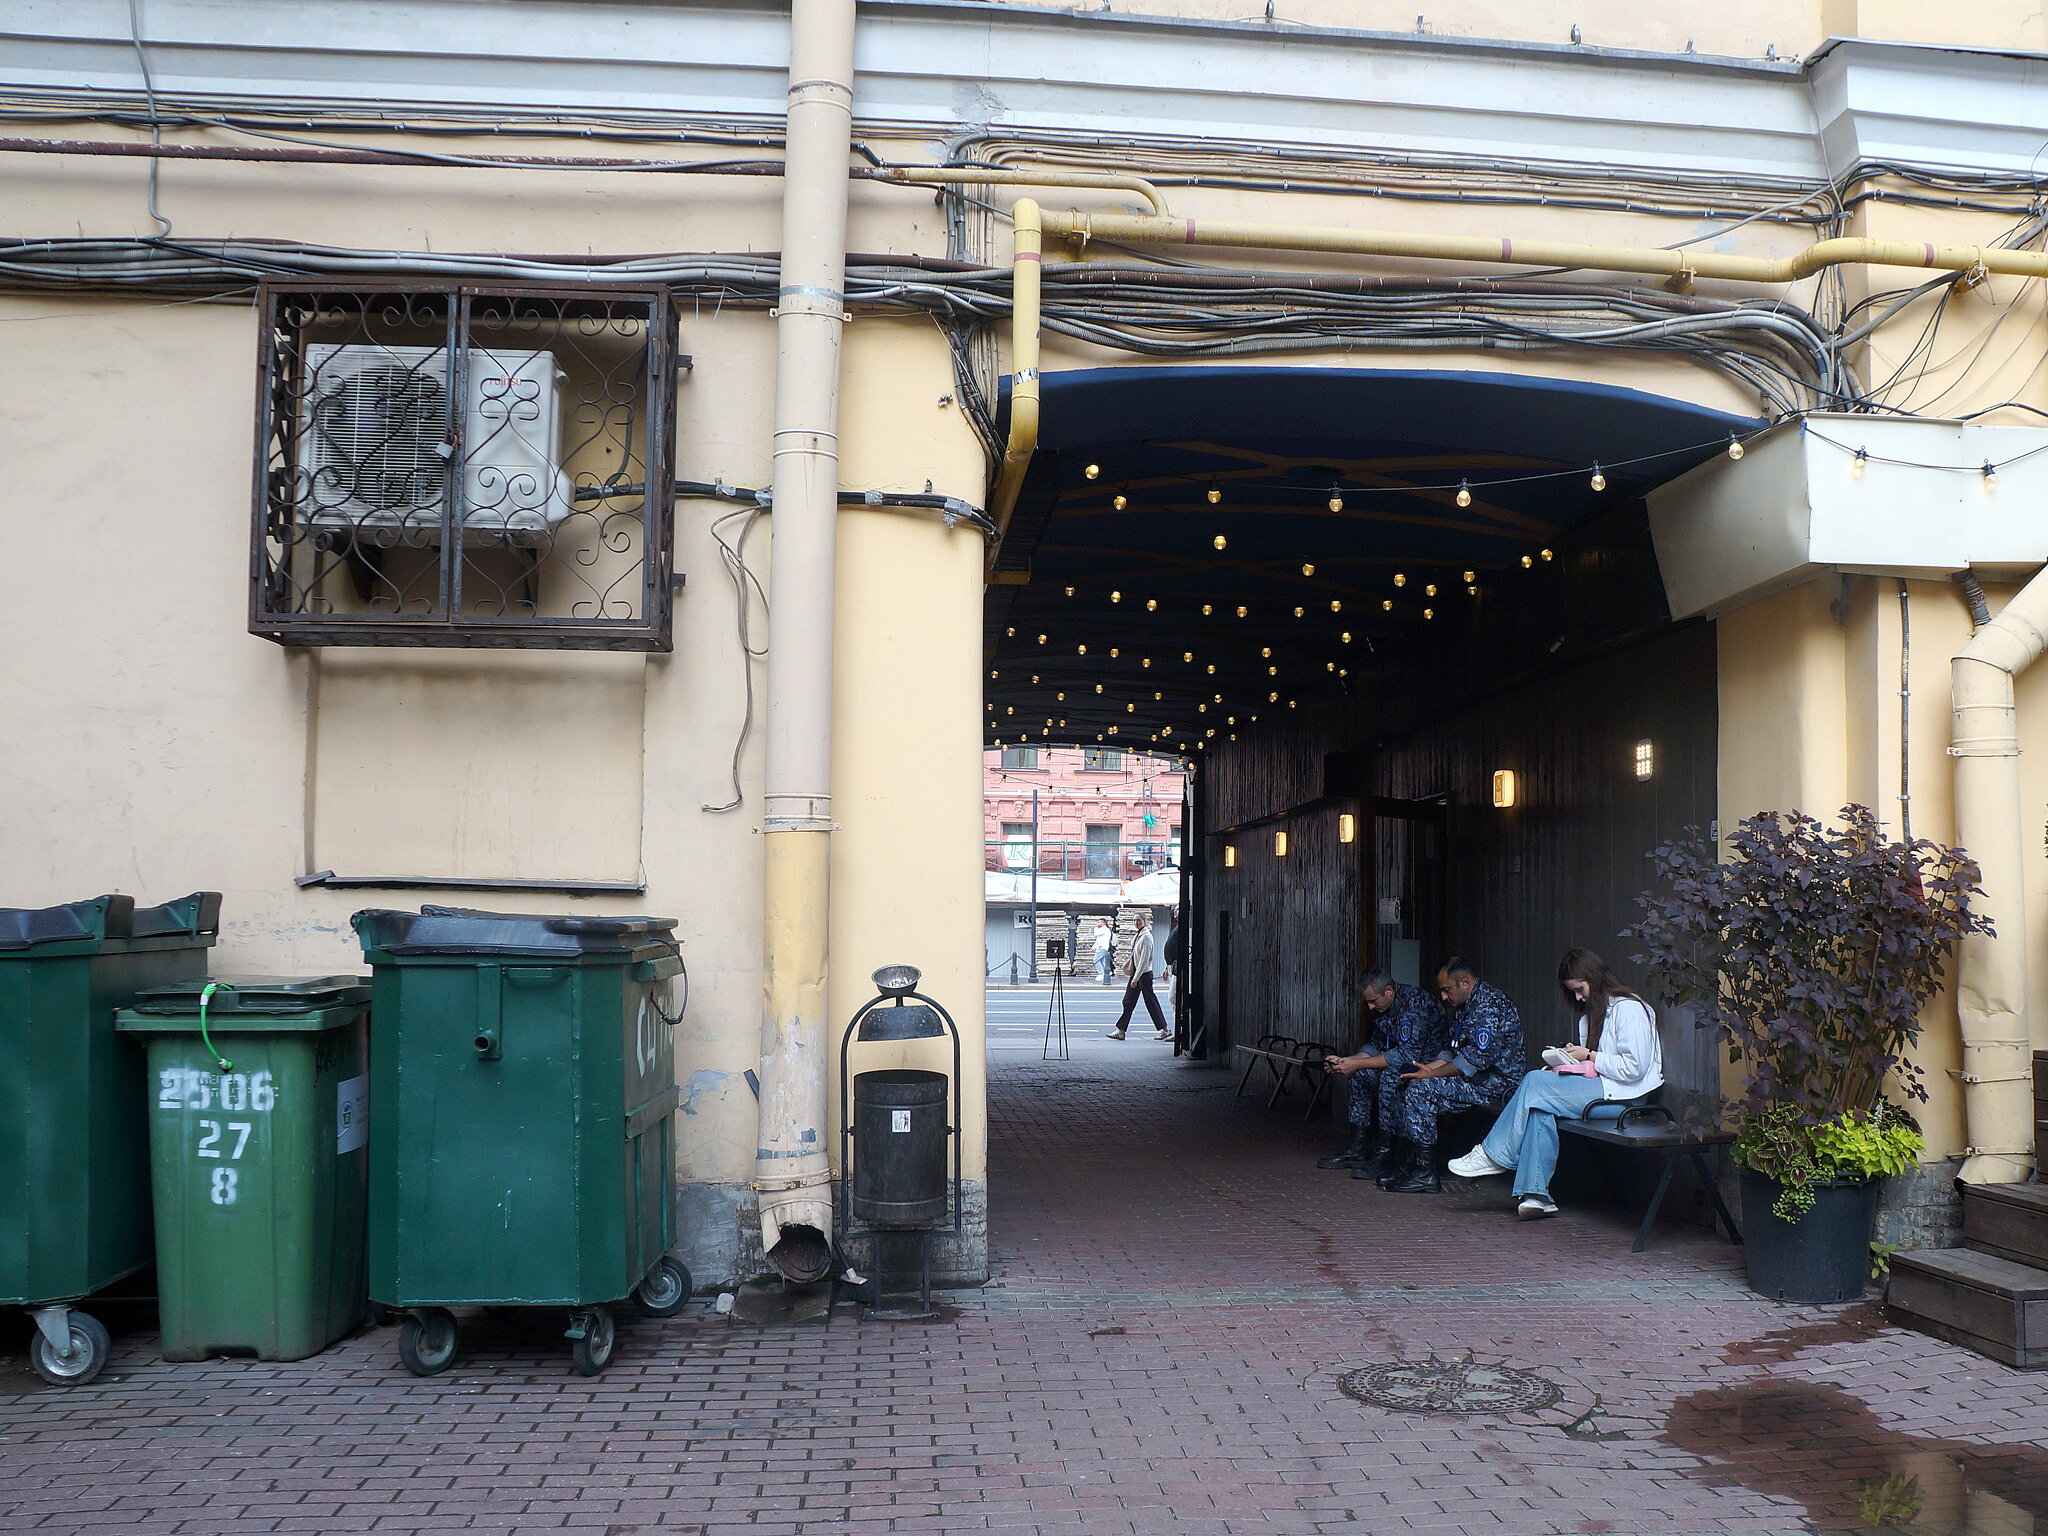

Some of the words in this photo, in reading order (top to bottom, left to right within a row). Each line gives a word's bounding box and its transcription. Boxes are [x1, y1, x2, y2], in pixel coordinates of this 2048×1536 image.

[1018, 914, 1033, 924] R
[197, 1119, 252, 1160] 27
[210, 1166, 239, 1206] 8
